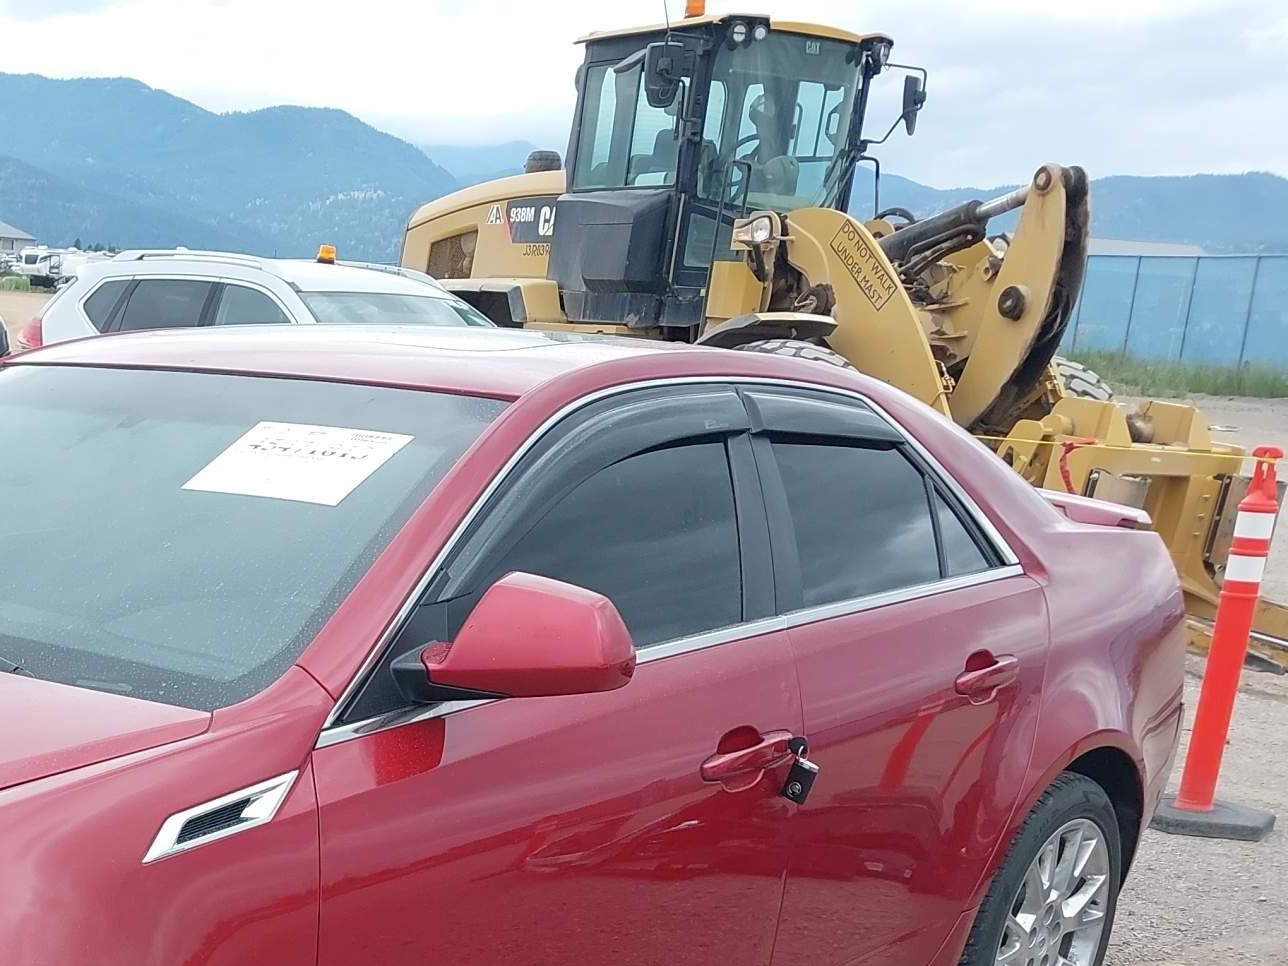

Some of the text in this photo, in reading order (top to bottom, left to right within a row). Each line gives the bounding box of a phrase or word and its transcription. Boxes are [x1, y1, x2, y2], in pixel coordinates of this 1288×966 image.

[805, 40, 820, 55] CAT
[509, 206, 535, 223] 938M
[836, 241, 883, 304] UNDER MAST
[841, 223, 894, 295] DO NOT WALK
